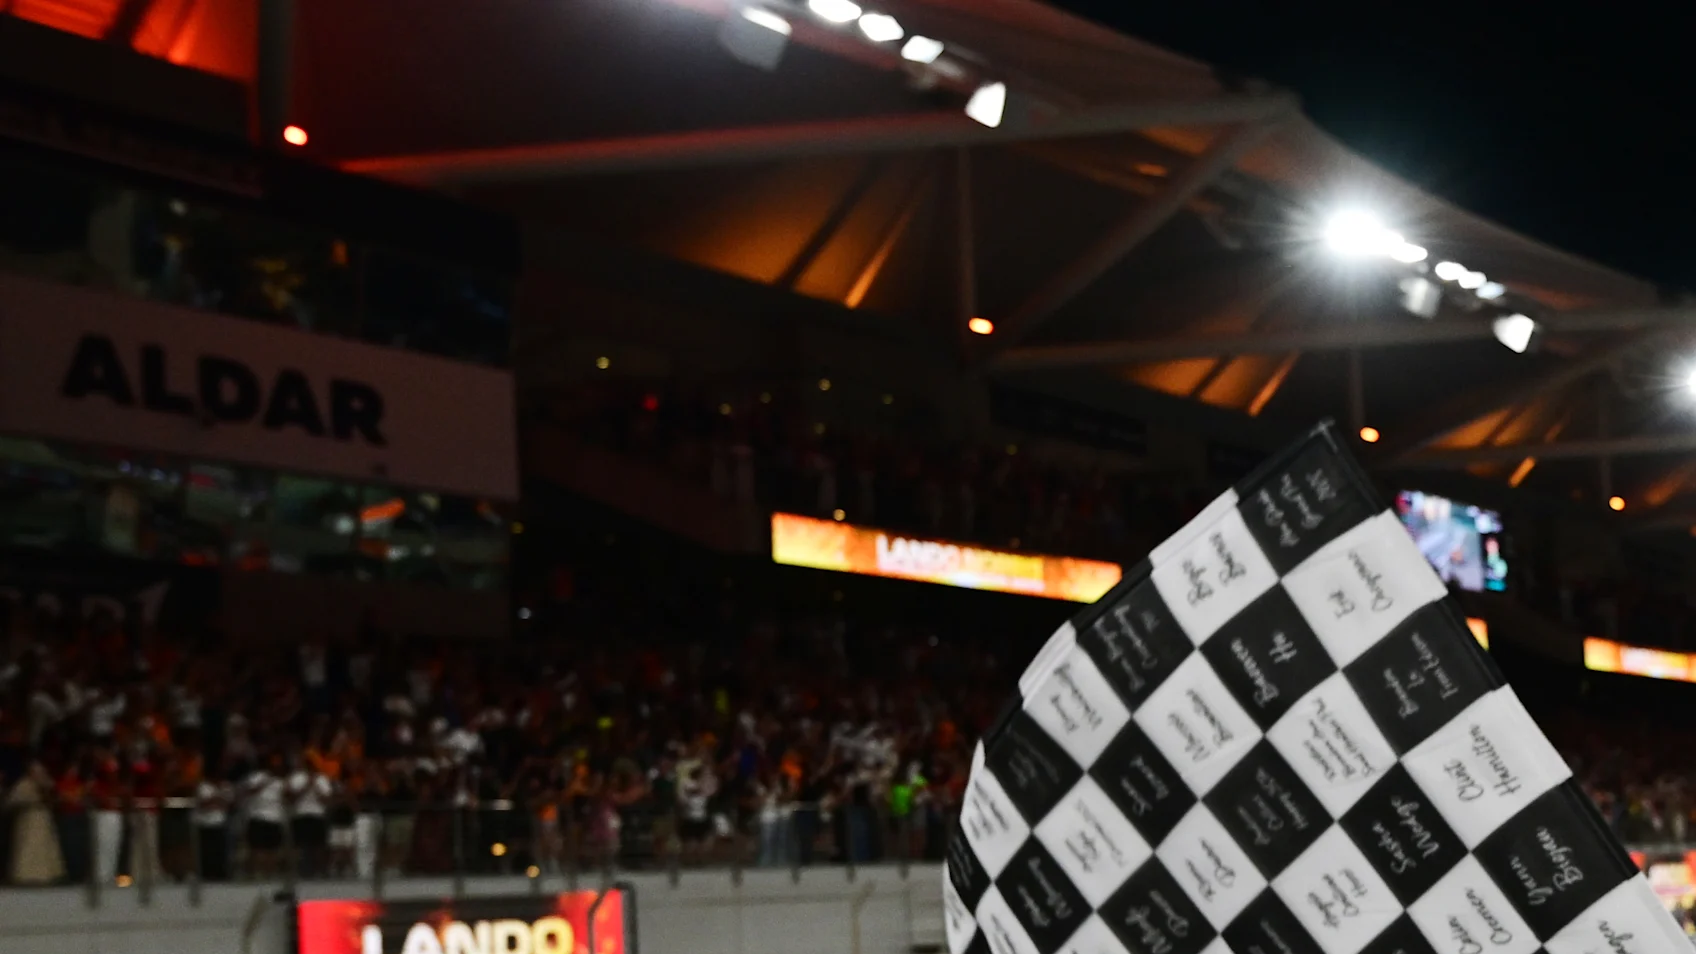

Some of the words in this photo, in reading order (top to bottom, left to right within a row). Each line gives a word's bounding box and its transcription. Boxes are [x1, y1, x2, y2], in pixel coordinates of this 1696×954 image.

[63, 334, 388, 446] ALDAR
[1443, 759, 1484, 802] Clint
[1468, 724, 1521, 796] Hamilton
[1371, 821, 1416, 874] Sasha
[1390, 798, 1440, 858] Wedge
